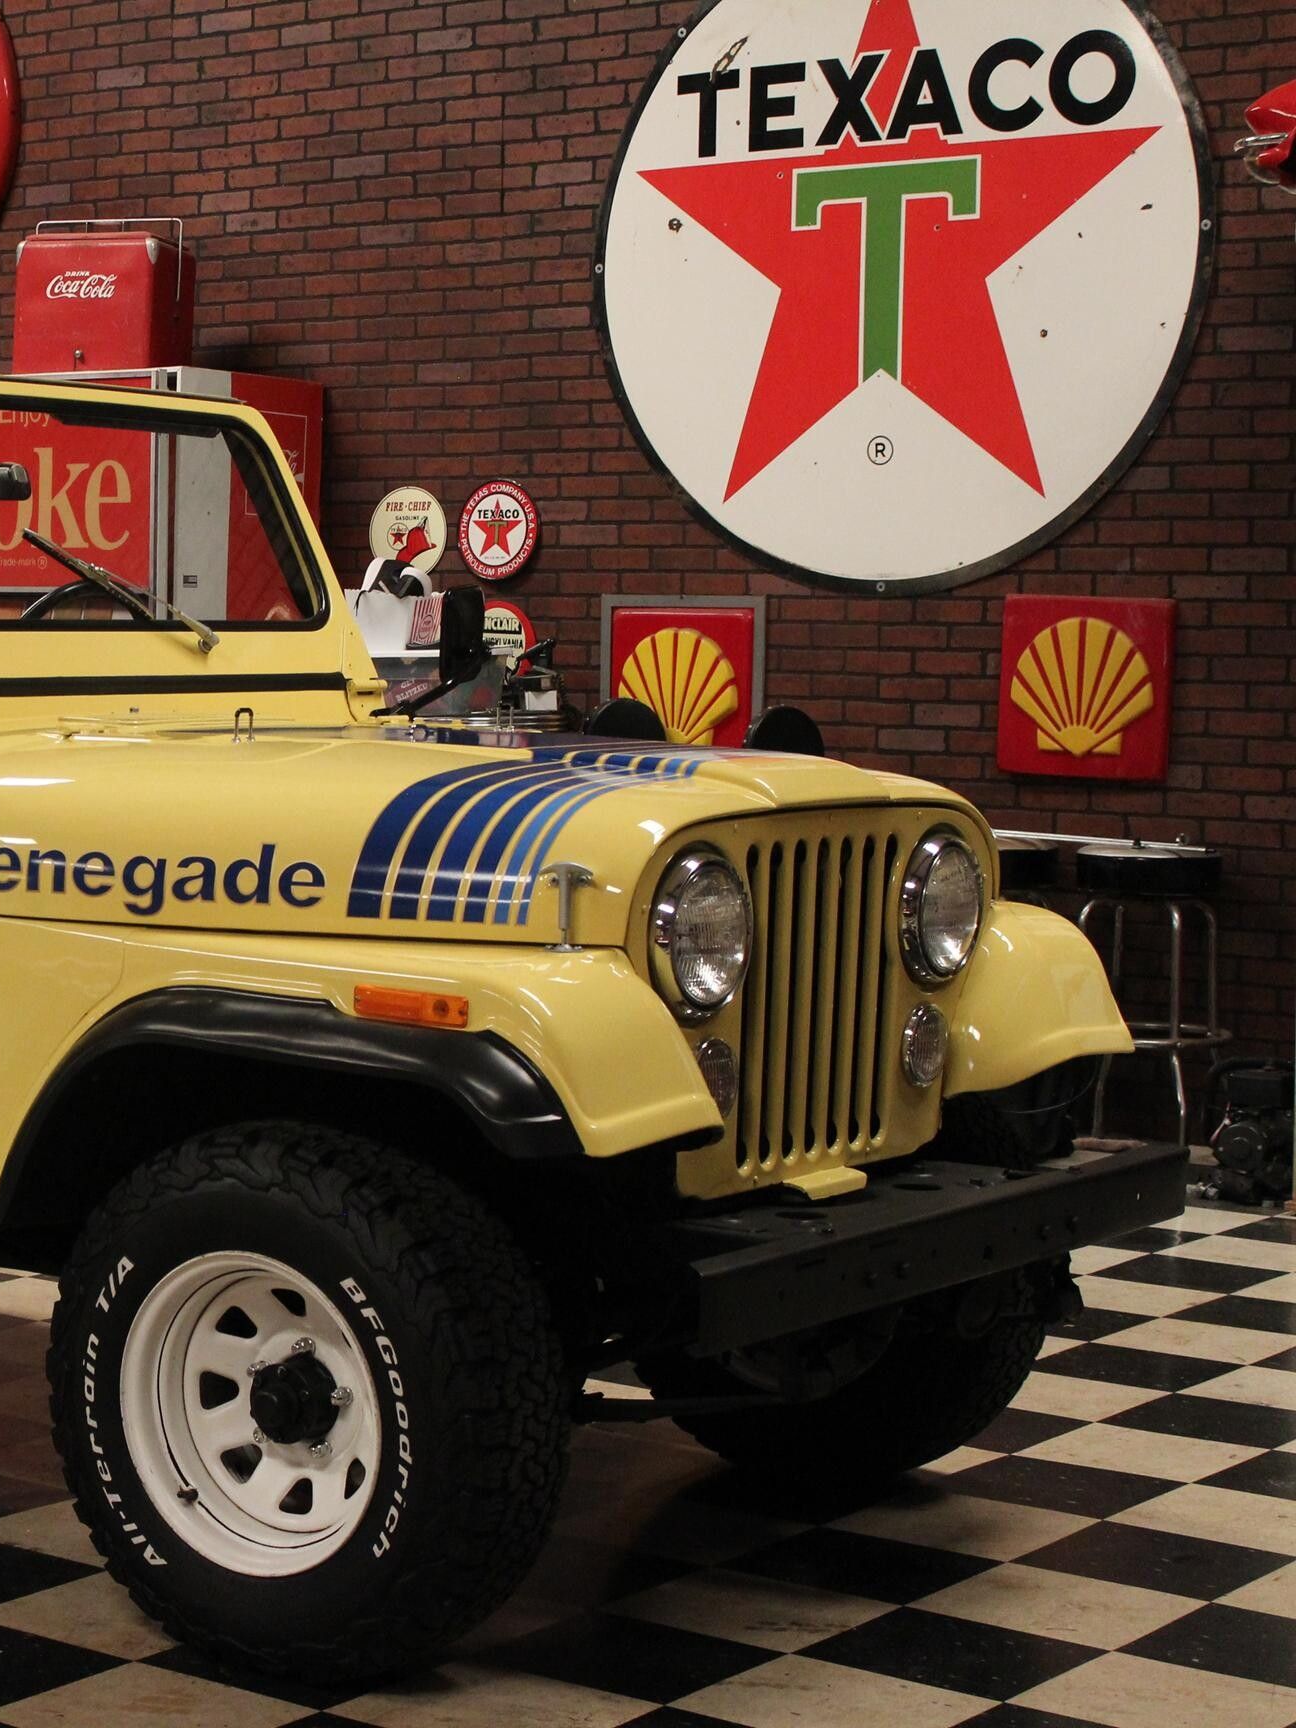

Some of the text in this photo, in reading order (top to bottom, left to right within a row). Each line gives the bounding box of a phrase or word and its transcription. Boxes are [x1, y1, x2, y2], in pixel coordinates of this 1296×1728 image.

[677, 29, 1136, 158] TEXACO
[46, 274, 118, 299] Coca-Cola
[0, 409, 51, 428] Enjoy
[460, 512, 470, 531] THE
[467, 487, 489, 511] TEXAS
[490, 484, 528, 504] COMPANY
[477, 509, 519, 519] TEXACO
[460, 538, 533, 576] PETROLEUM PRODUCTS
[484, 617, 519, 631] NCLAIR
[84, 1256, 167, 1565] All-Terrain T/A
[339, 1277, 413, 1559] BFGoodrich
